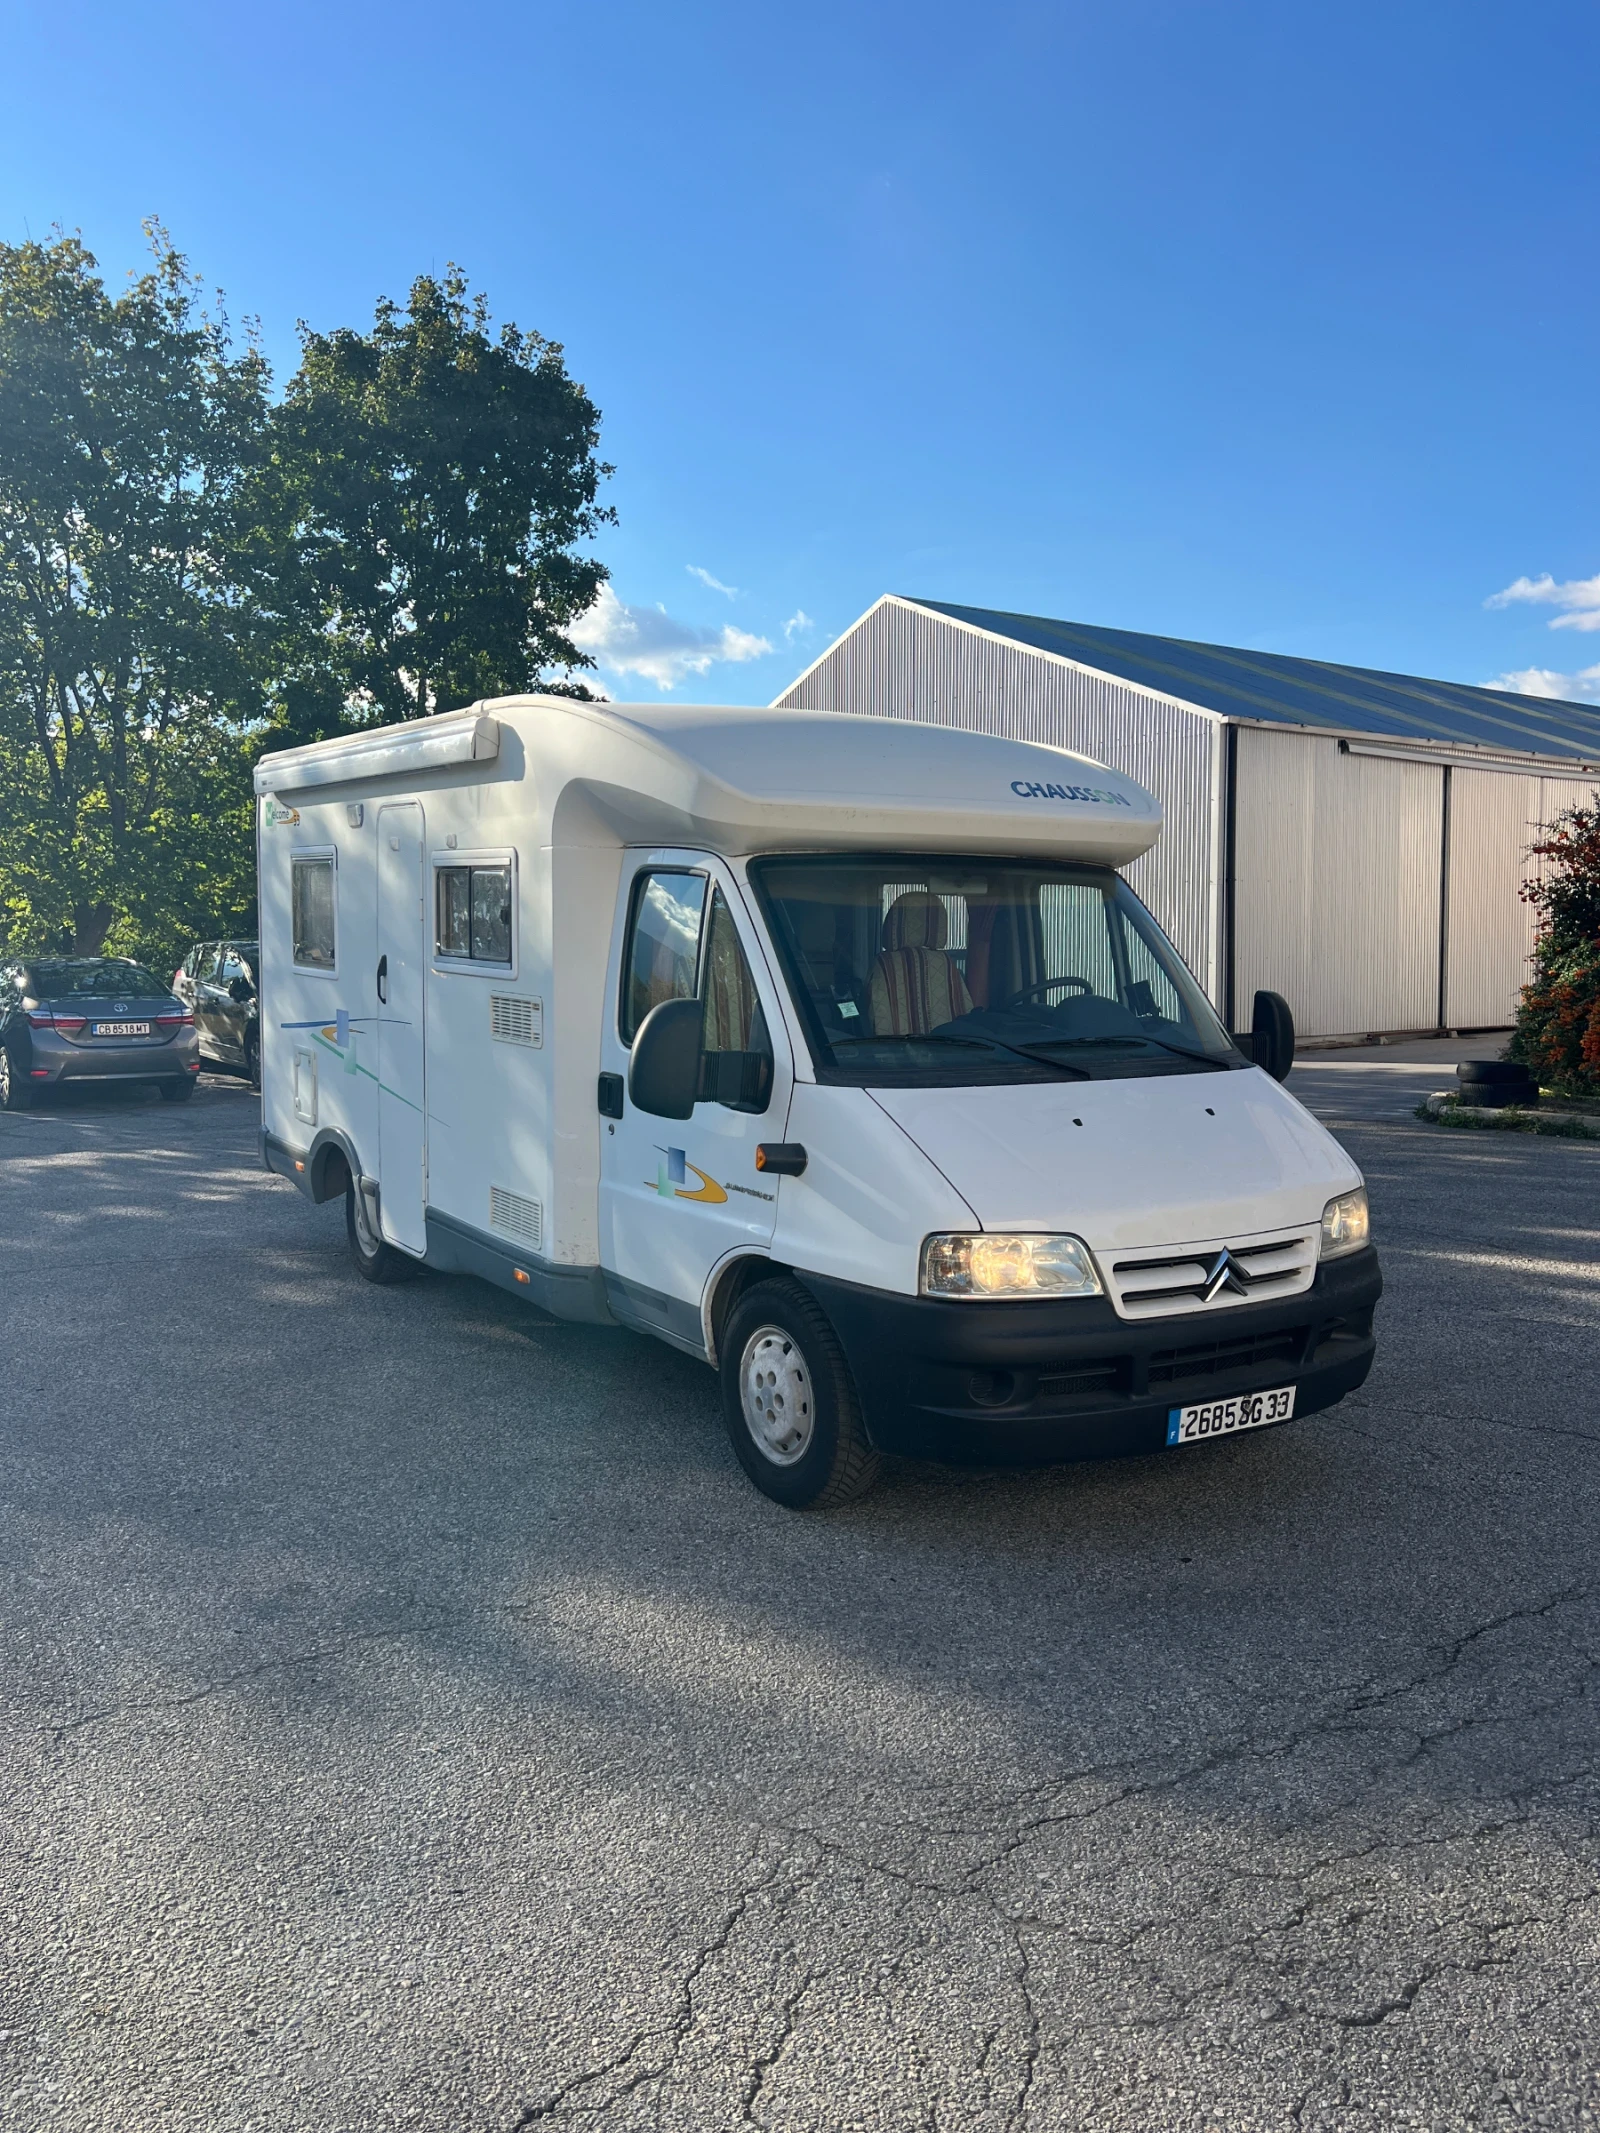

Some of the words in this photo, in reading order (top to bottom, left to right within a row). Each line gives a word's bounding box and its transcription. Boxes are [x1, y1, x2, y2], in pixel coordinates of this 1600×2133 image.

[1010, 780, 1131, 806] CHAUSSON
[98, 1025, 111, 1034] CB
[112, 1024, 135, 1034] 8518
[136, 1023, 148, 1033] MT
[1185, 1401, 1237, 1437] 2685
[1266, 1391, 1290, 1420] 33
